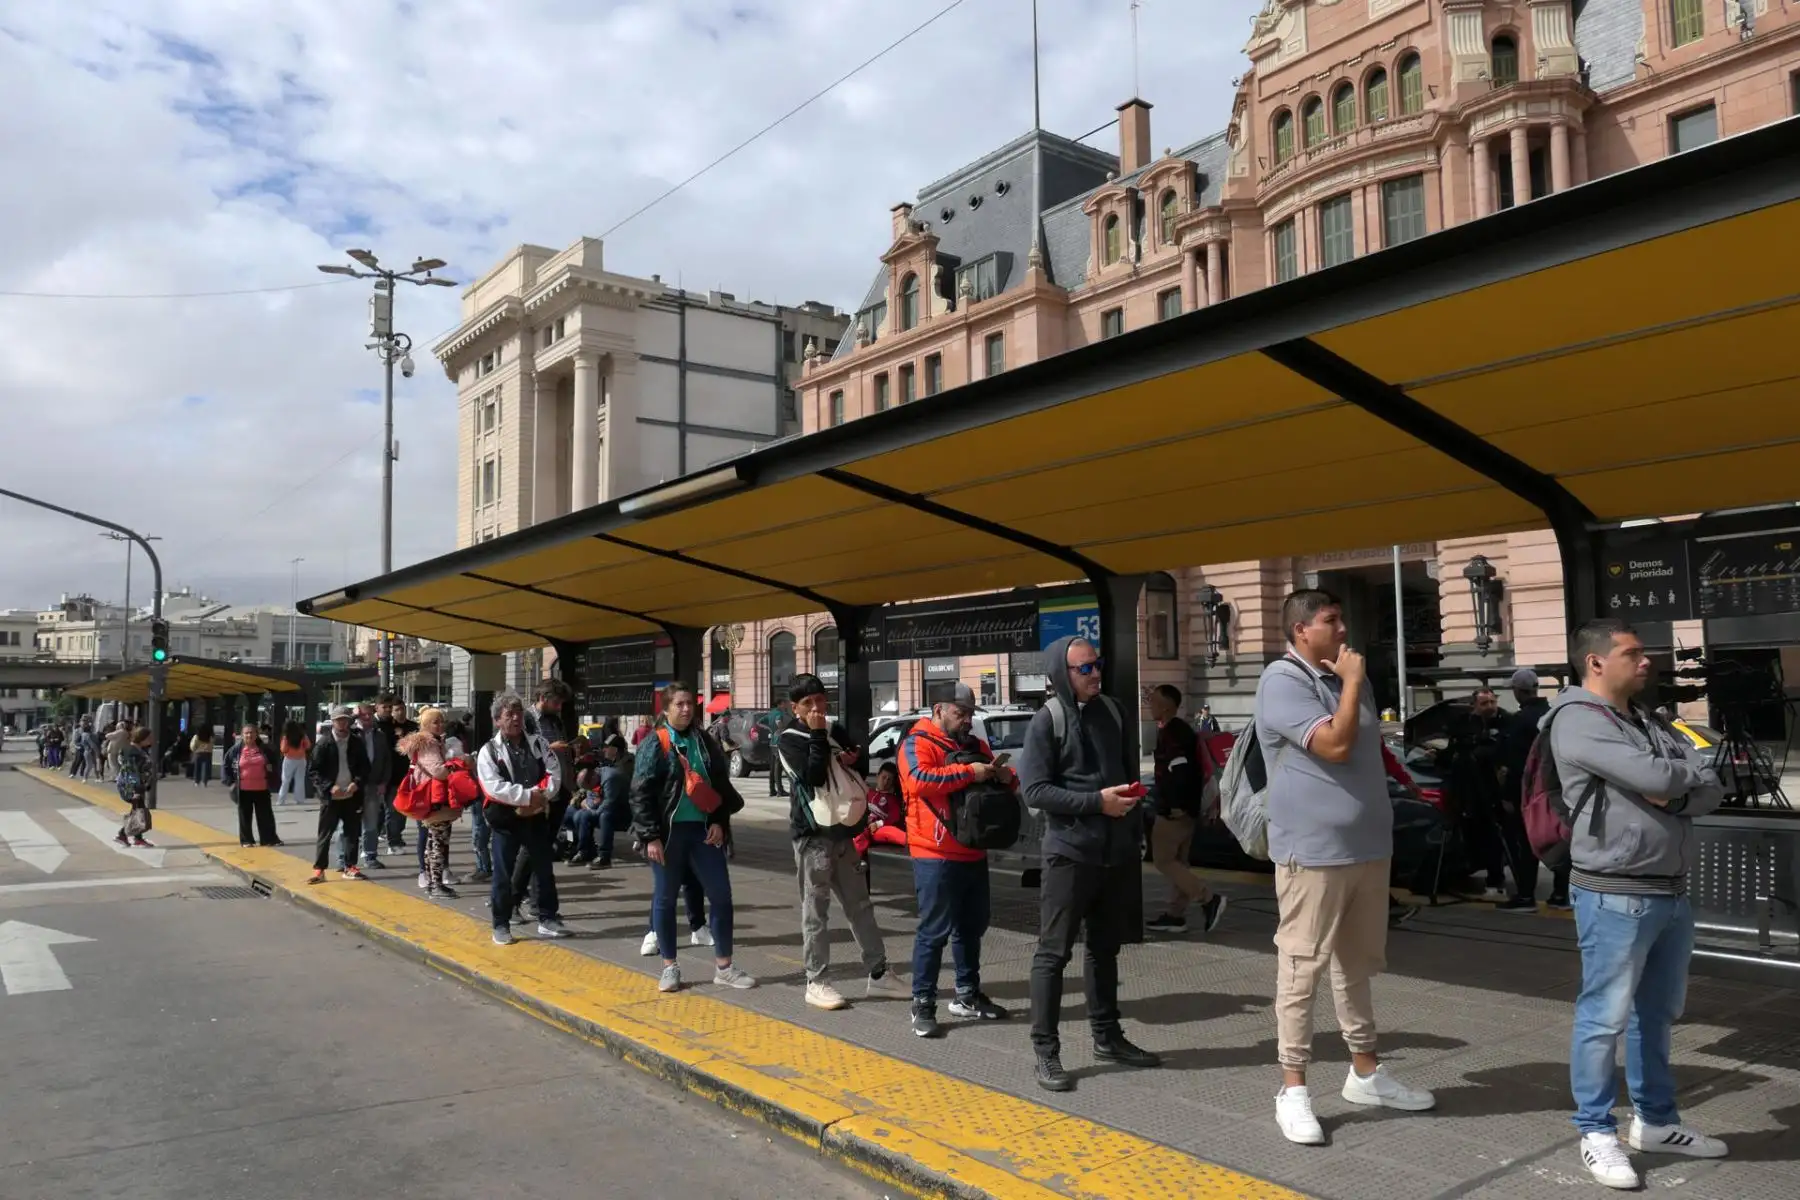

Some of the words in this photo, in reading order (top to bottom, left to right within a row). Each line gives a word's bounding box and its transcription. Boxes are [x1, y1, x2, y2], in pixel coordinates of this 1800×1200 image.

[1628, 559, 1664, 569] Demos
[1630, 566, 1674, 582] prioridad
[1076, 615, 1100, 640] 53
